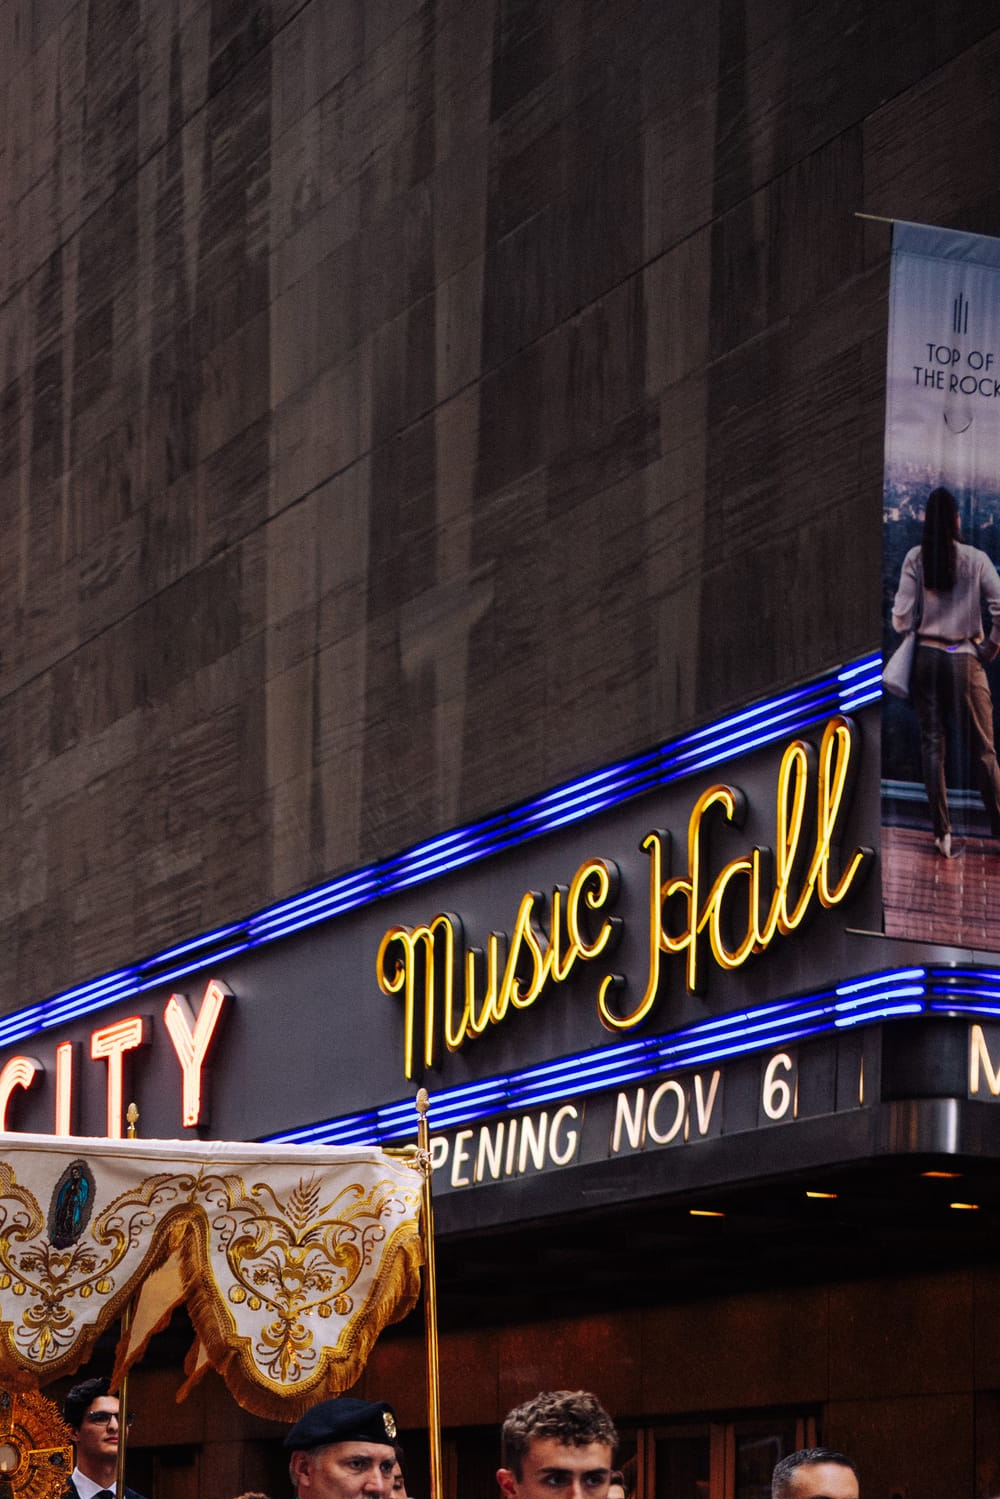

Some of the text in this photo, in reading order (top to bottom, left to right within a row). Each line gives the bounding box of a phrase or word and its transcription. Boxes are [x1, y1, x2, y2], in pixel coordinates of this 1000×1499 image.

[913, 366, 945, 390] THE
[926, 343, 994, 371] TOP OF
[377, 714, 876, 1082] Music Hall
[403, 1052, 793, 1188] PENING NOV 6
